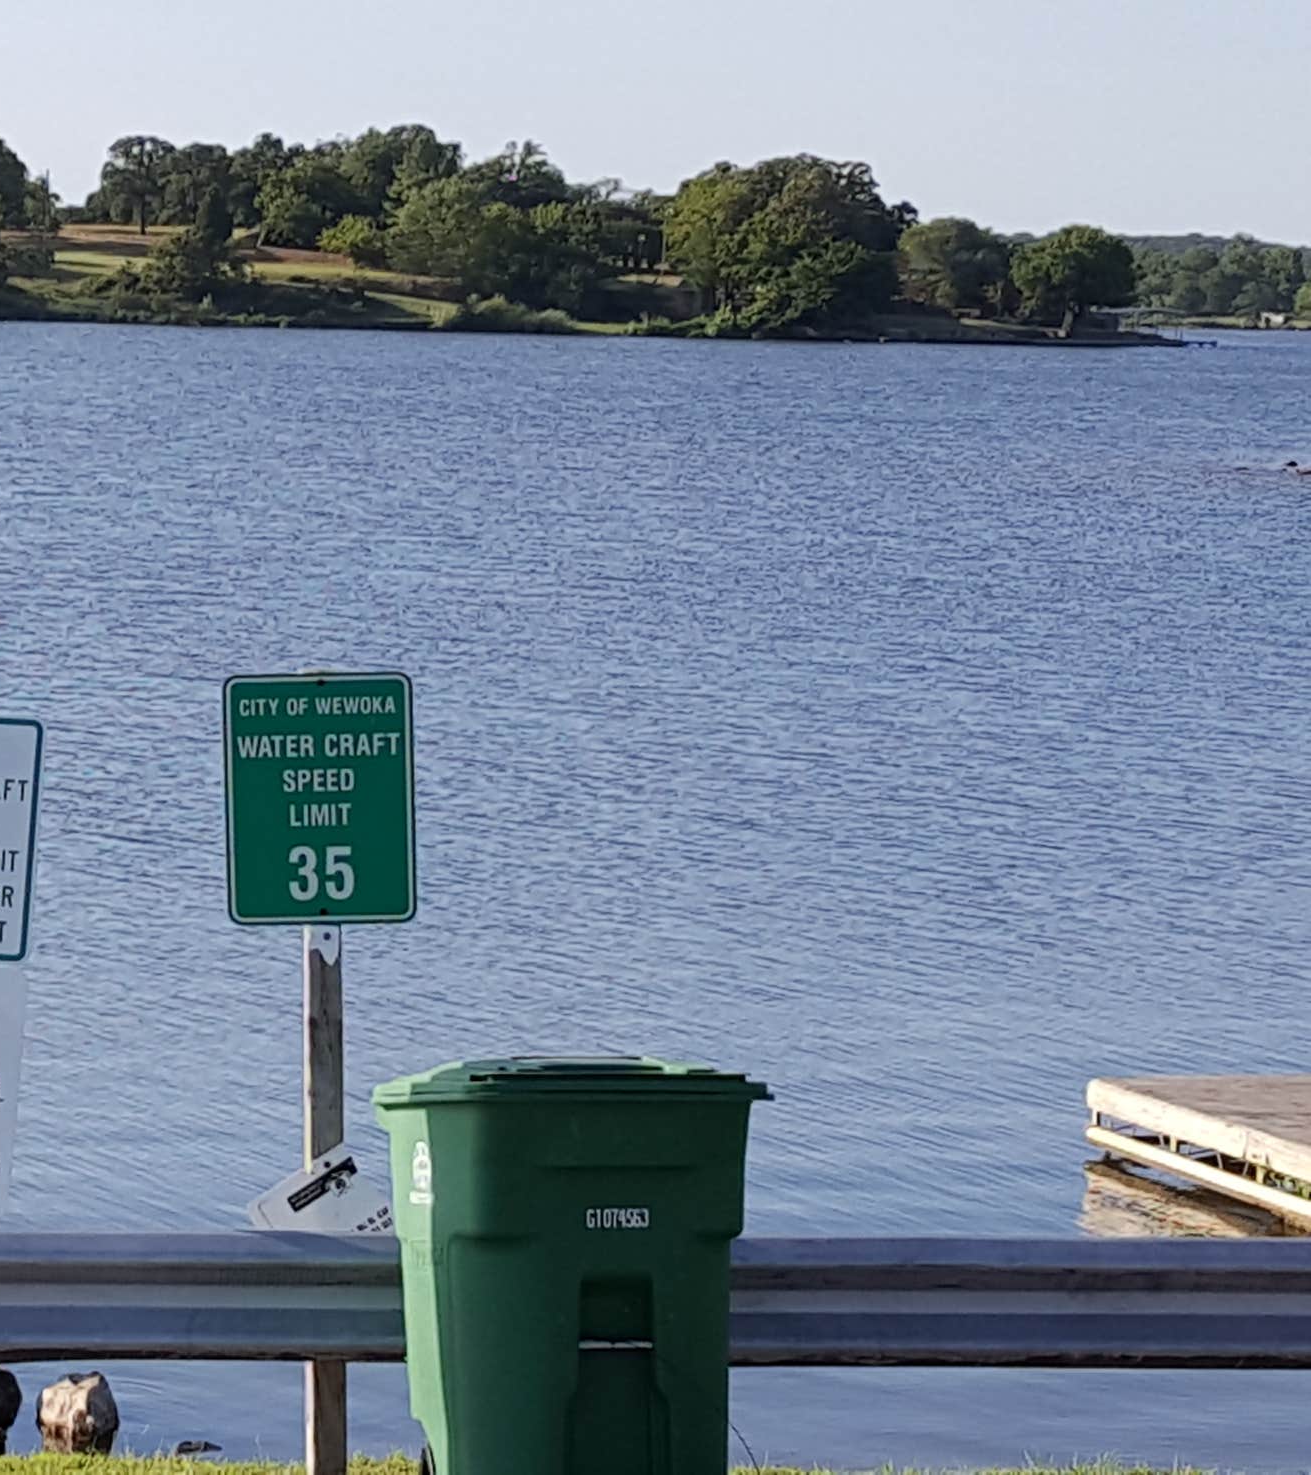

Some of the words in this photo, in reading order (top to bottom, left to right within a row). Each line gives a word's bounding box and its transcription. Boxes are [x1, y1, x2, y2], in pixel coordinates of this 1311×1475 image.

[239, 698, 279, 717] CITY
[286, 697, 309, 716] OF
[315, 696, 396, 715] WEWOKA
[237, 735, 314, 758] WATER
[324, 732, 400, 757] CRAFT
[283, 768, 355, 793] SPEED
[290, 803, 352, 827] LIMIT
[289, 846, 355, 901] 35
[586, 1208, 649, 1228] G1074563
